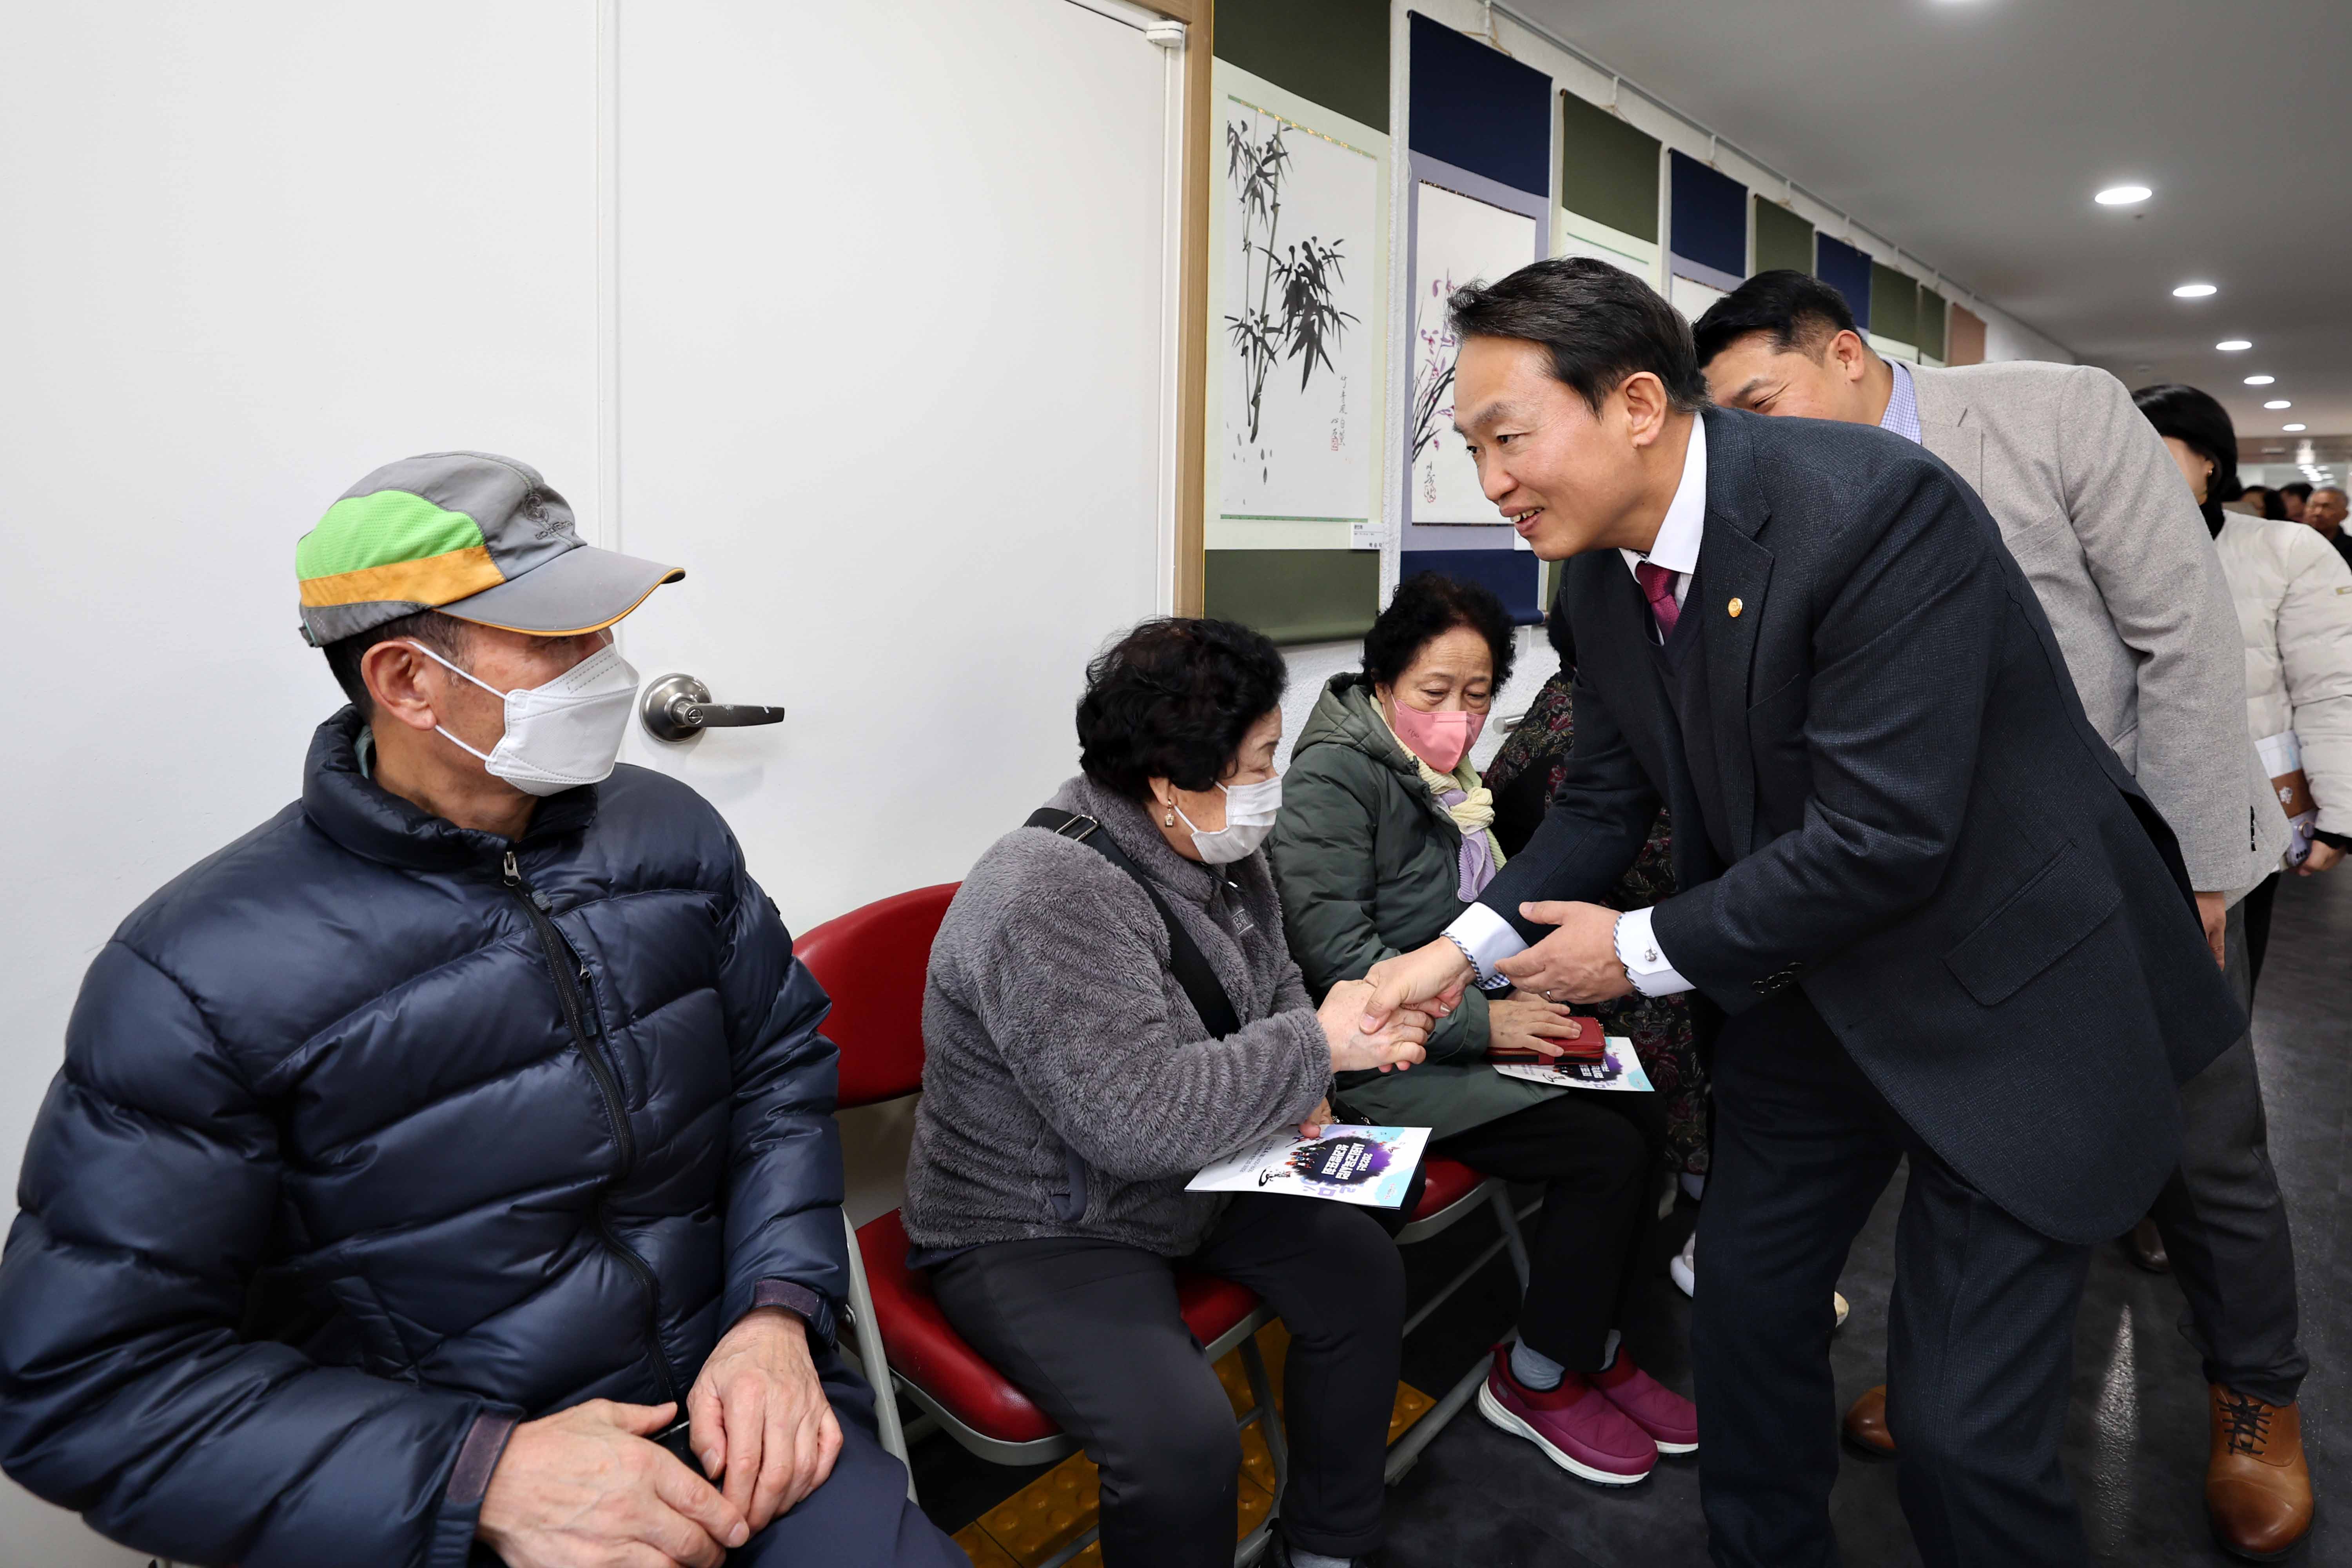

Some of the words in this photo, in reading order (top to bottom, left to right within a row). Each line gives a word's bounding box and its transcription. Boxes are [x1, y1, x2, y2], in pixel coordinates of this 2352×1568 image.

[1321, 1144, 1349, 1175] 성과발표회
[1335, 1143, 1365, 1180] 사회교육사업
[1356, 1153, 1373, 1171] 2023년
